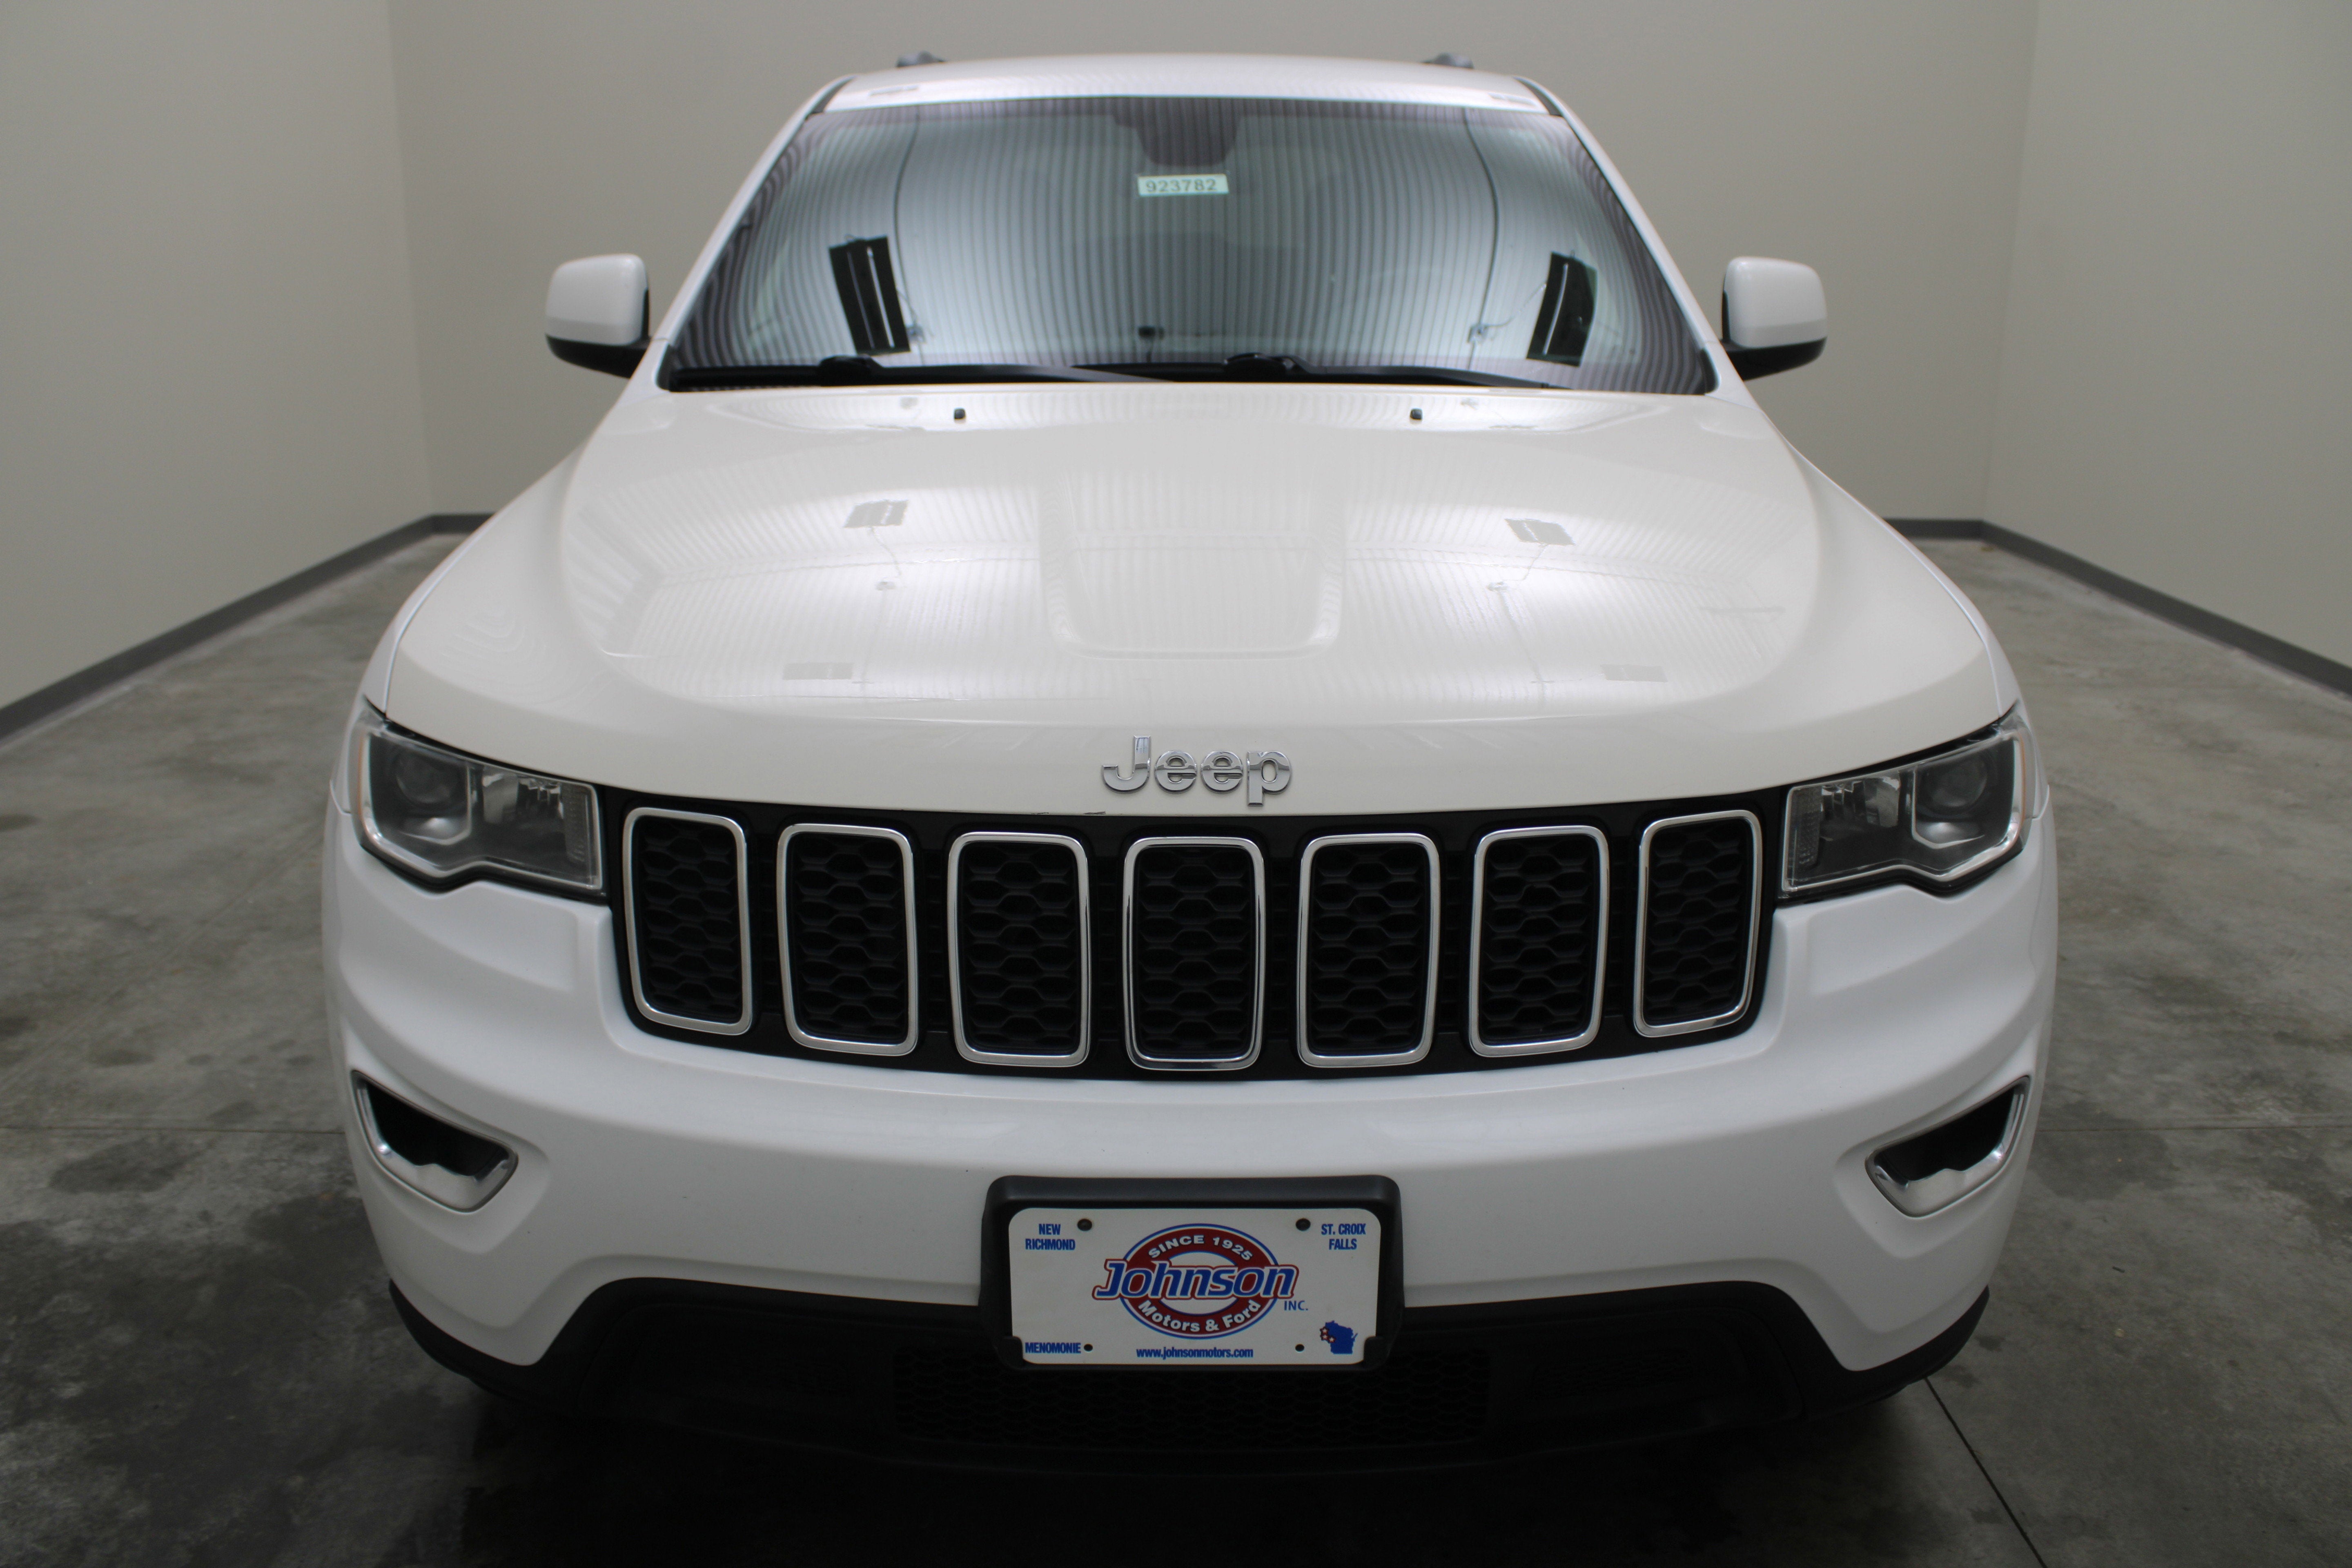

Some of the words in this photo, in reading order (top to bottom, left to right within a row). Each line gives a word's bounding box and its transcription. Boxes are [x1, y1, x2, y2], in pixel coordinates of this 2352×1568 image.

[1146, 179, 1217, 193] 923782
[1102, 735, 1292, 806] Jeep
[1038, 1223, 1061, 1235] NEW
[1321, 1223, 1336, 1235] ST.
[1338, 1223, 1366, 1235] CROIX
[1025, 1238, 1076, 1250] RICHMOND
[1148, 1235, 1205, 1258] SINCE
[1213, 1236, 1254, 1261] 1925
[1329, 1238, 1357, 1250] FALLS
[1094, 1261, 1297, 1298] Johnson
[1284, 1301, 1308, 1311] INC.
[1138, 1300, 1200, 1332] Motors
[1205, 1319, 1219, 1332] &
[1222, 1299, 1261, 1328] Ford
[1025, 1342, 1081, 1354] MENOMONIE
[1136, 1347, 1254, 1360] www.johnsonmotors.com
